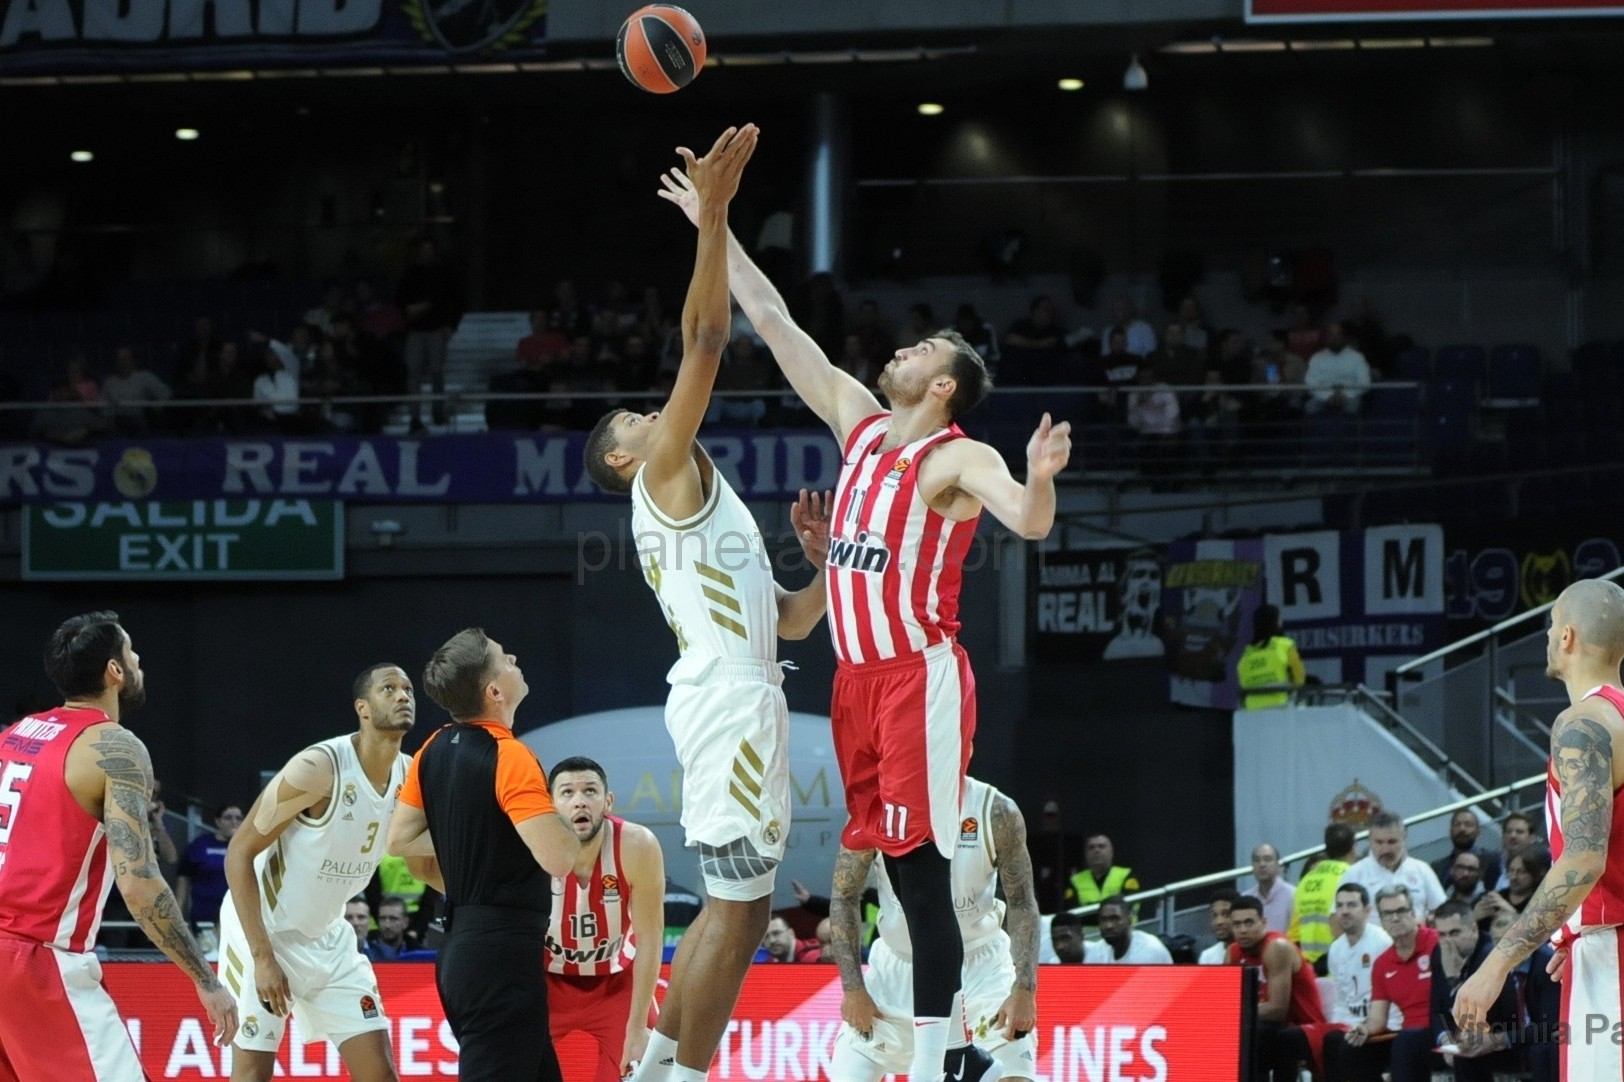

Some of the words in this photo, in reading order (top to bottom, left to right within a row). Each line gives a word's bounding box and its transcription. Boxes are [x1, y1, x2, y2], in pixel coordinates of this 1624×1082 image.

[222, 440, 452, 495] REAL
[119, 533, 240, 571] EXIT
[828, 532, 888, 573] win
[1280, 546, 1323, 607] R
[1382, 536, 1426, 601] M
[1037, 590, 1117, 634] REAL
[360, 821, 380, 854] 3
[884, 803, 908, 841] 11
[569, 912, 597, 940] 16
